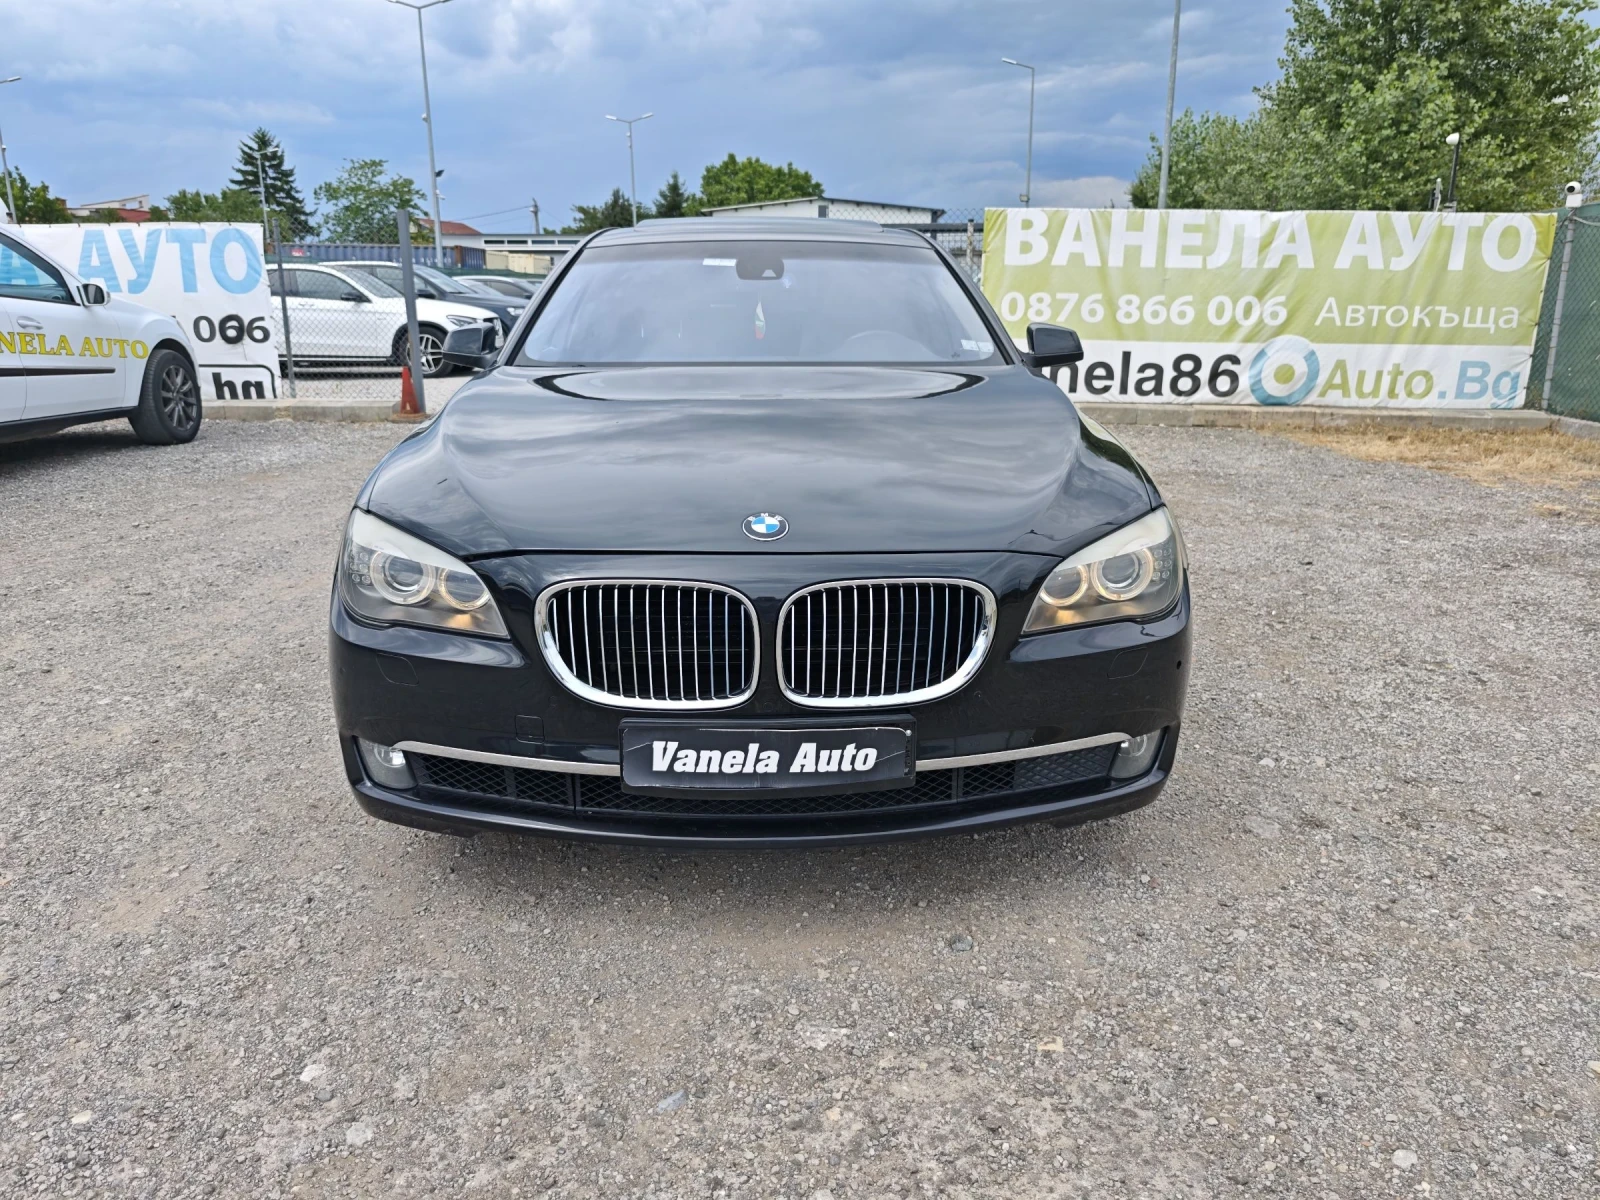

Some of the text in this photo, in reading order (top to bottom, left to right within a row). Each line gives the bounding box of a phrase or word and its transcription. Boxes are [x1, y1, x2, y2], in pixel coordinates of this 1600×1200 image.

[1004, 210, 1537, 272] ВАНЕЛА АУТО
[78, 228, 262, 294] АУТО
[1000, 291, 1288, 327] 0876 866 006
[1314, 296, 1520, 334] Автокъща
[78, 336, 149, 360] AUTO
[1316, 358, 1521, 410] Auto.Bg
[652, 740, 779, 774] Vanela
[789, 742, 878, 773] Auto
